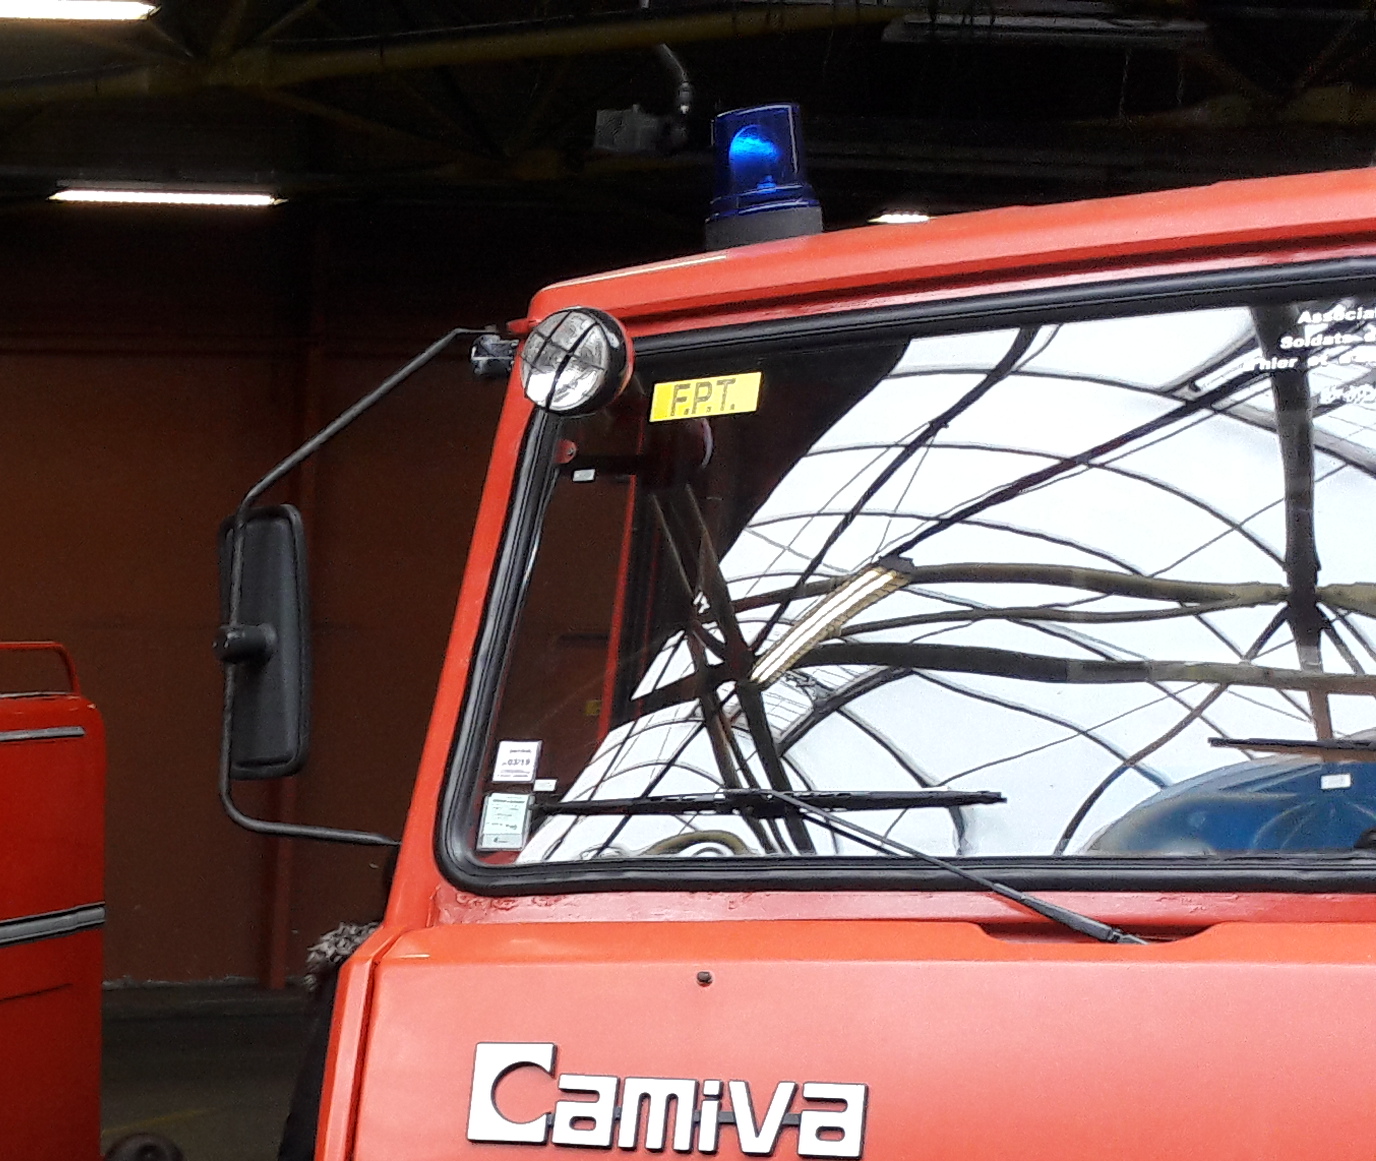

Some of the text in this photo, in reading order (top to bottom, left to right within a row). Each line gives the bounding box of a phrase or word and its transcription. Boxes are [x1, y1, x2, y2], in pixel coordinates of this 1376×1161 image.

[1297, 306, 1376, 324] Associa
[670, 378, 736, 416] F.P.T.
[467, 1042, 868, 1160] Camiva
